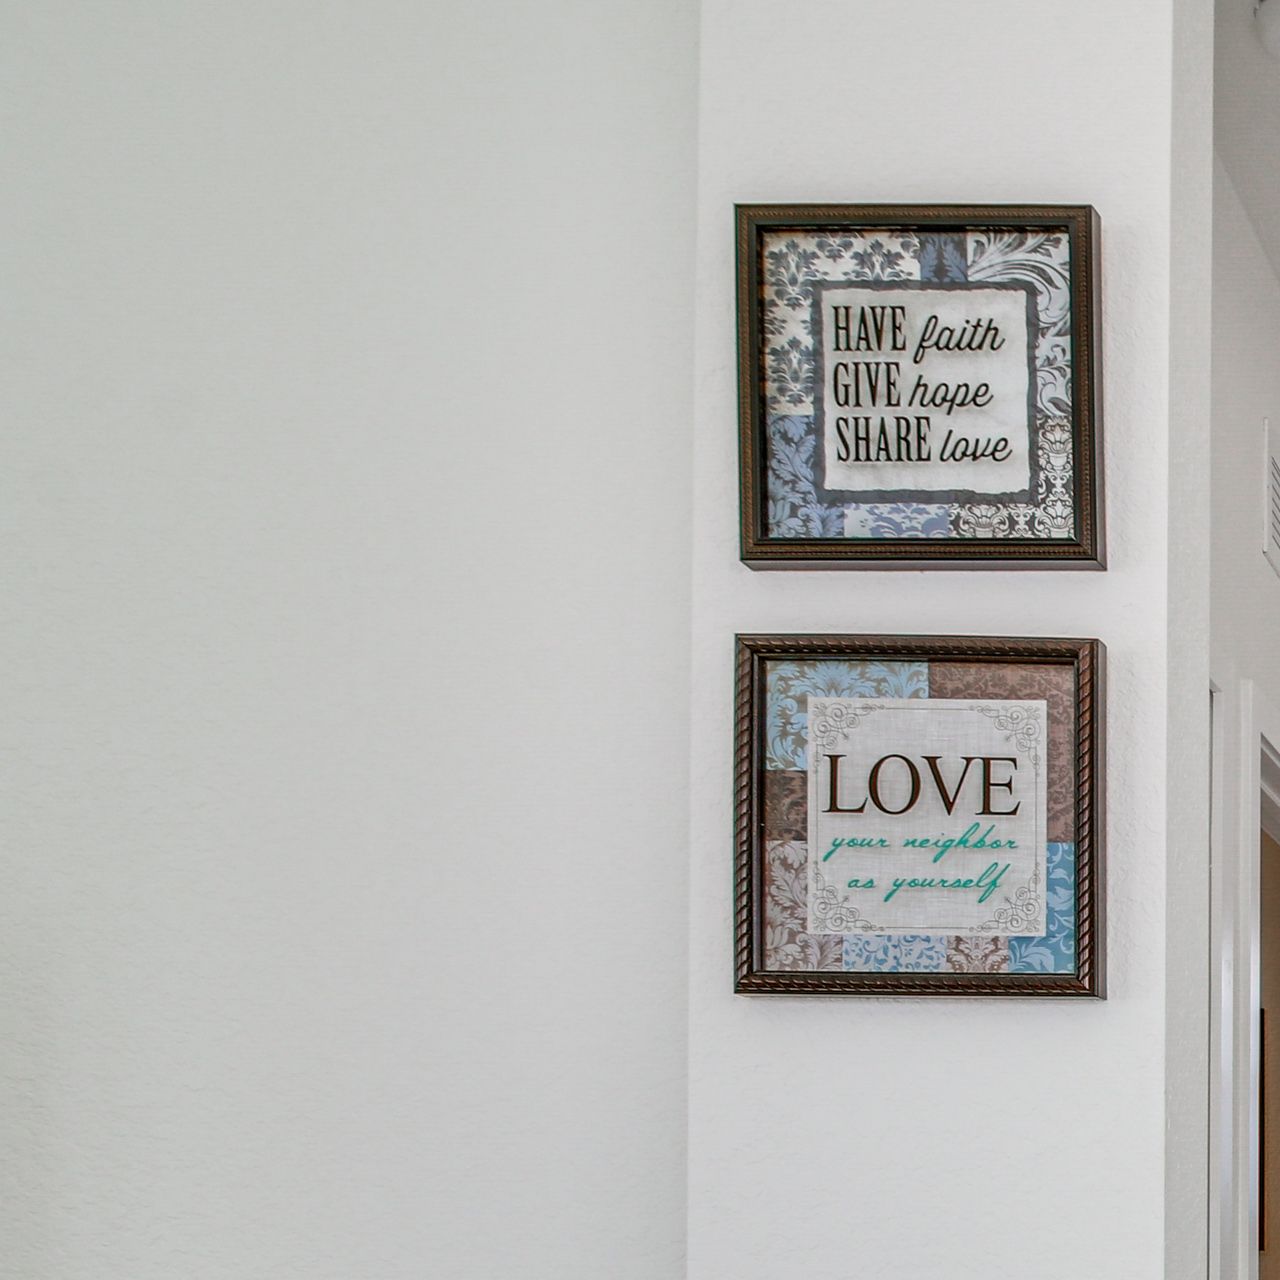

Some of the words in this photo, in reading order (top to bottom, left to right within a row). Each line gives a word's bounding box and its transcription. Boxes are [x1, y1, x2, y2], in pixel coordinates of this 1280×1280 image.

[832, 305, 907, 352] HAVE
[913, 315, 1006, 365] faith
[833, 361, 901, 408] GIVE
[907, 374, 994, 416] hope
[836, 415, 932, 463] SHARE
[939, 429, 1013, 463] love
[821, 753, 1021, 817] LOVE
[822, 837, 890, 862] your
[903, 822, 1019, 863] neighbor
[847, 877, 875, 890] as
[883, 862, 1011, 904] yourself
